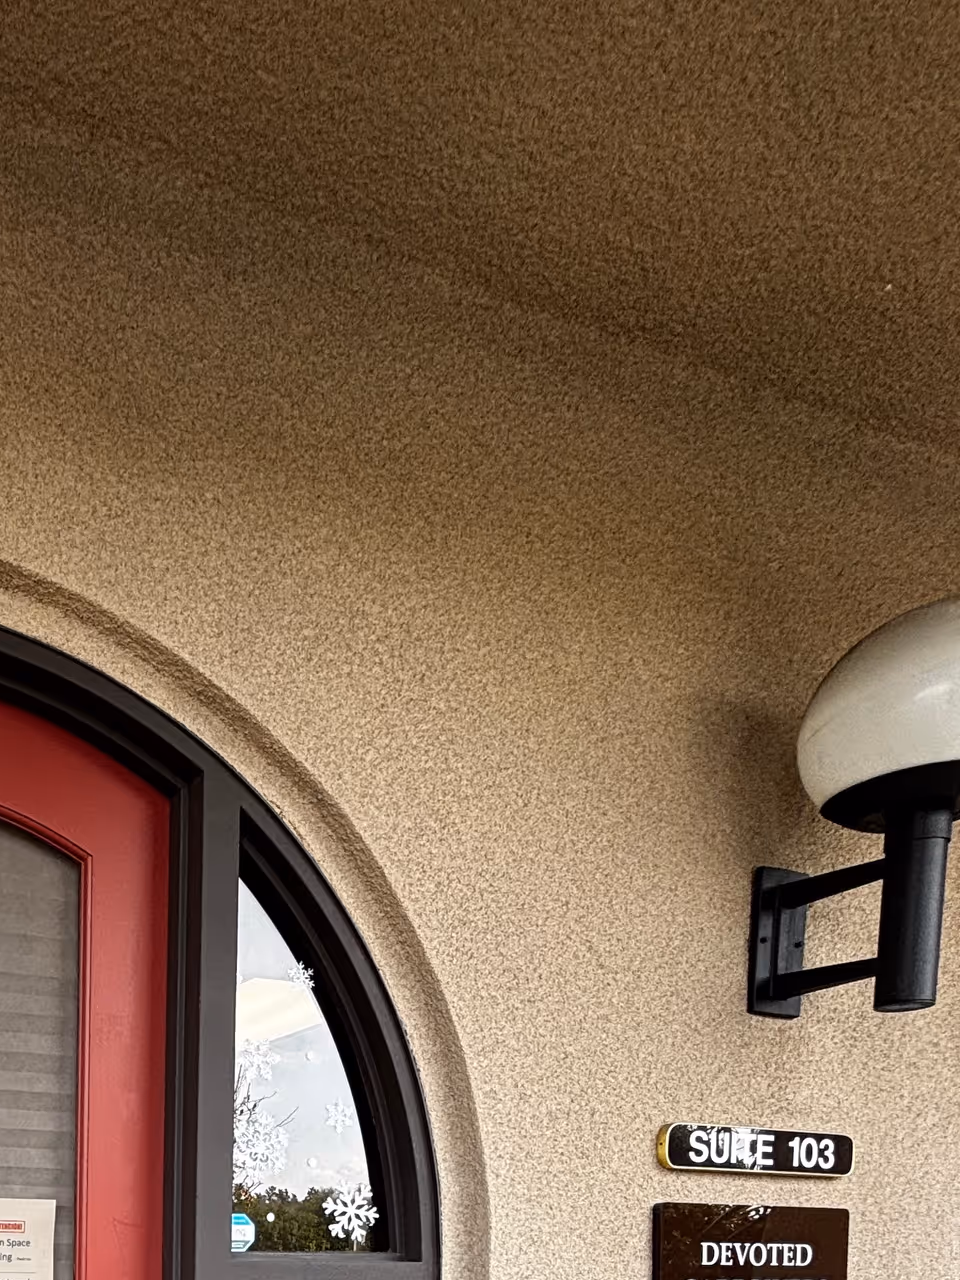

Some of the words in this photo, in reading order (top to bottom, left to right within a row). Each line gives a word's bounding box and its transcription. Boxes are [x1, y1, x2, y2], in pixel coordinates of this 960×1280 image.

[689, 1129, 774, 1166] SUITE
[789, 1136, 835, 1169] 103
[7, 1240, 30, 1251] Space
[701, 1242, 812, 1267] DEVOTED
